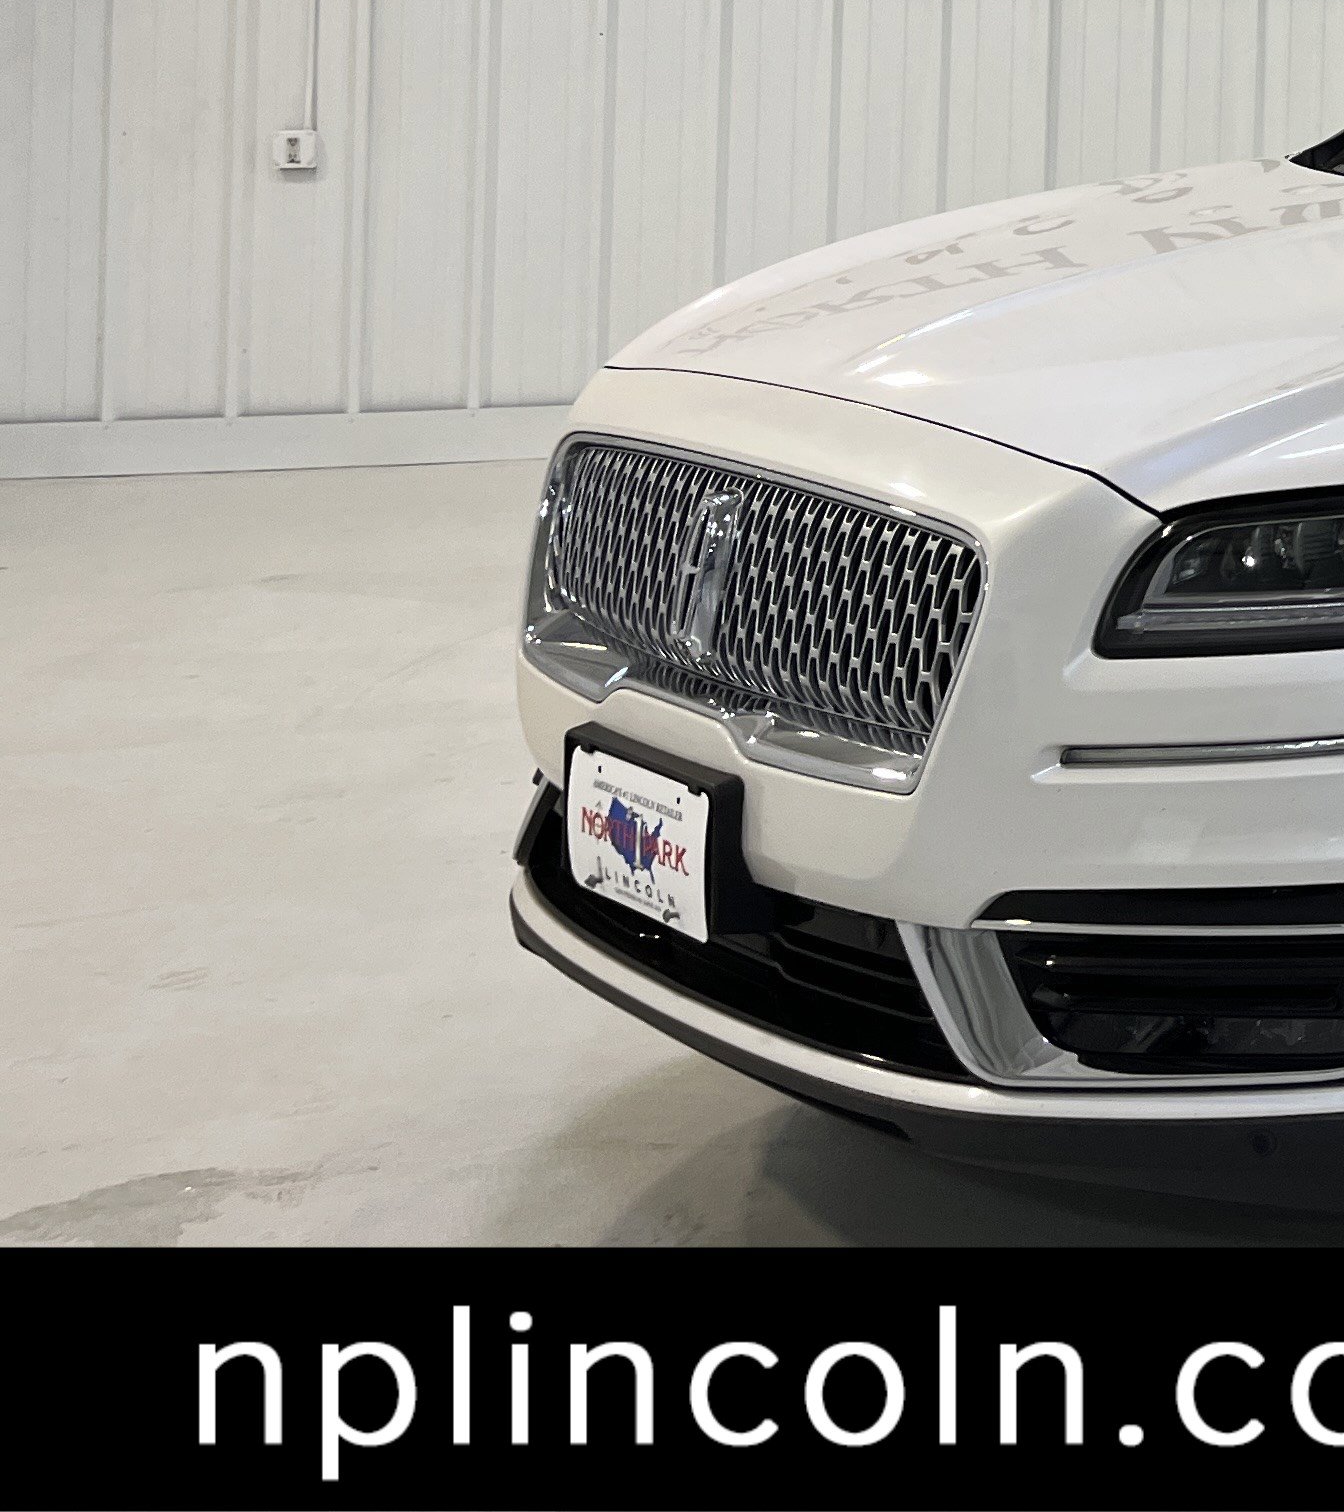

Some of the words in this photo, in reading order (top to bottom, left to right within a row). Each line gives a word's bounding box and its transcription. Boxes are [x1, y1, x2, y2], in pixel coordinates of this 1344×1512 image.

[581, 806, 637, 852] NORTH
[643, 828, 690, 876] PARK
[604, 866, 676, 908] LINCOLN
